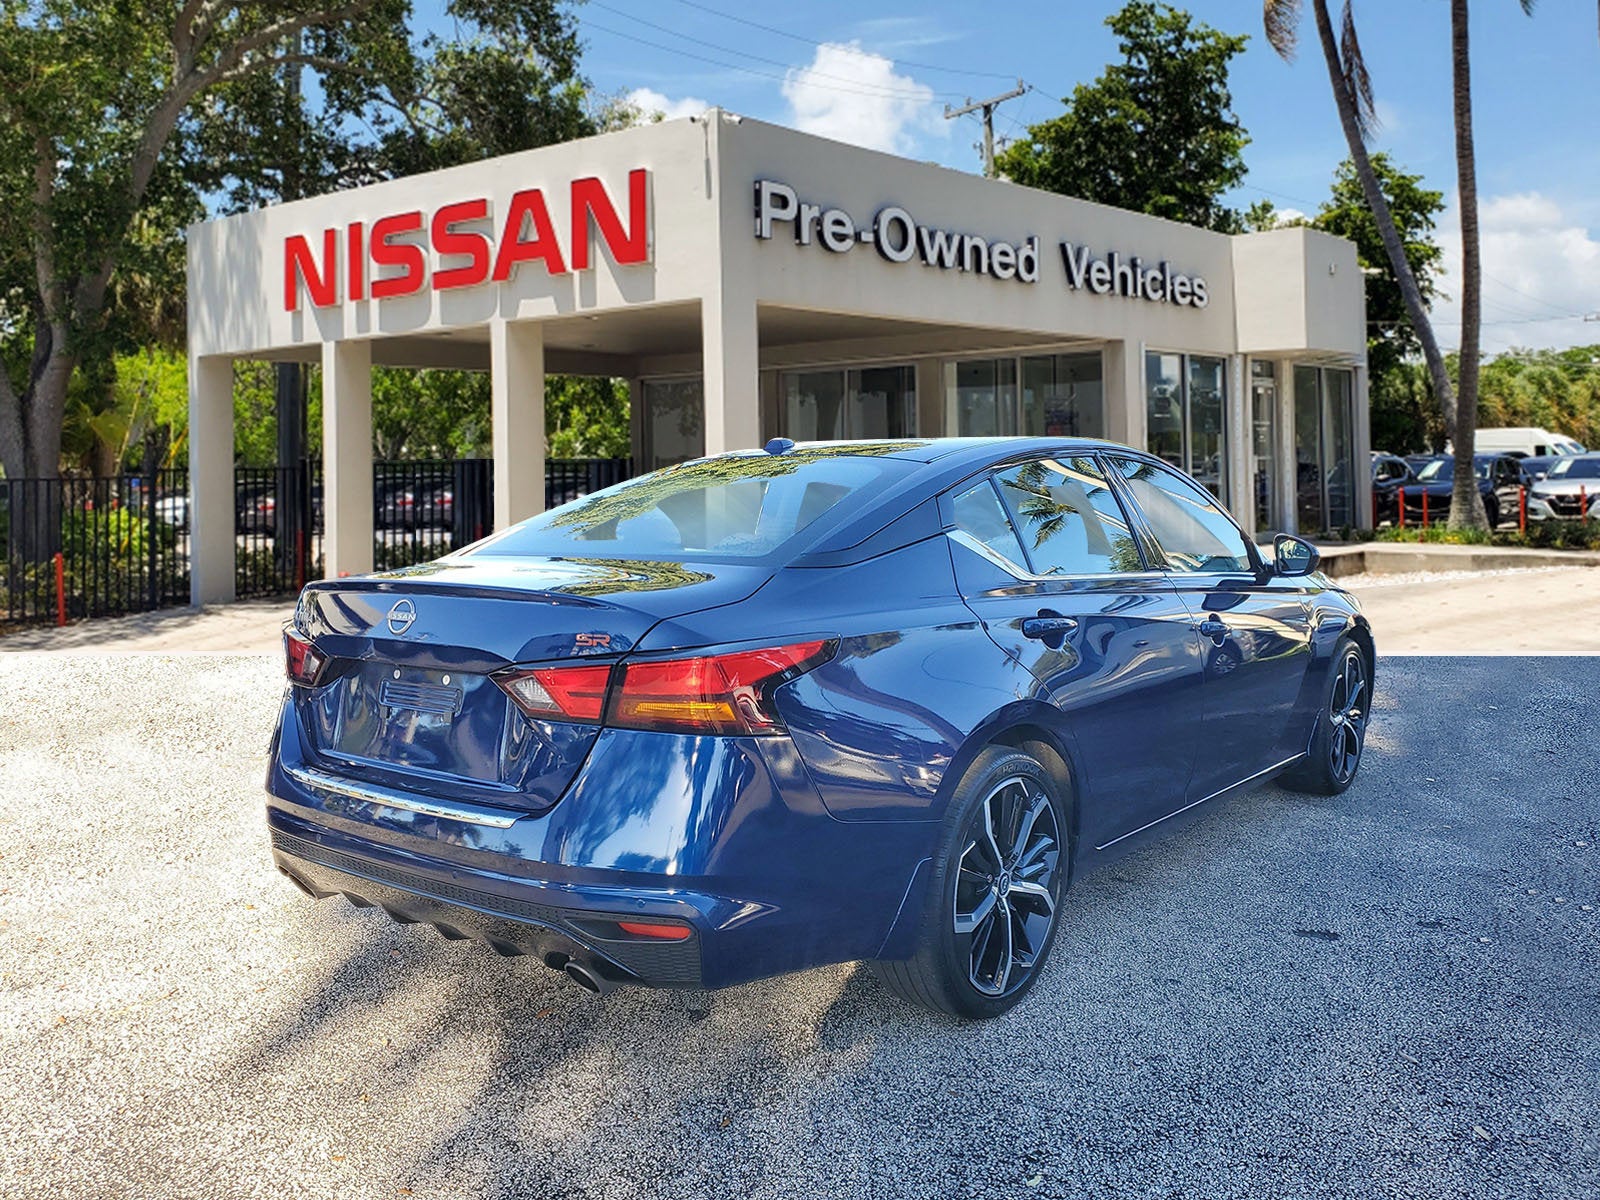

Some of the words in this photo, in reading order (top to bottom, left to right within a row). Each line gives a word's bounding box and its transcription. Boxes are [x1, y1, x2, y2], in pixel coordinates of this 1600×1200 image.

[285, 168, 649, 312] NISSAN
[755, 179, 1040, 283] Pre-Owned
[1060, 242, 1209, 309] Vehicles
[575, 633, 611, 648] SR
